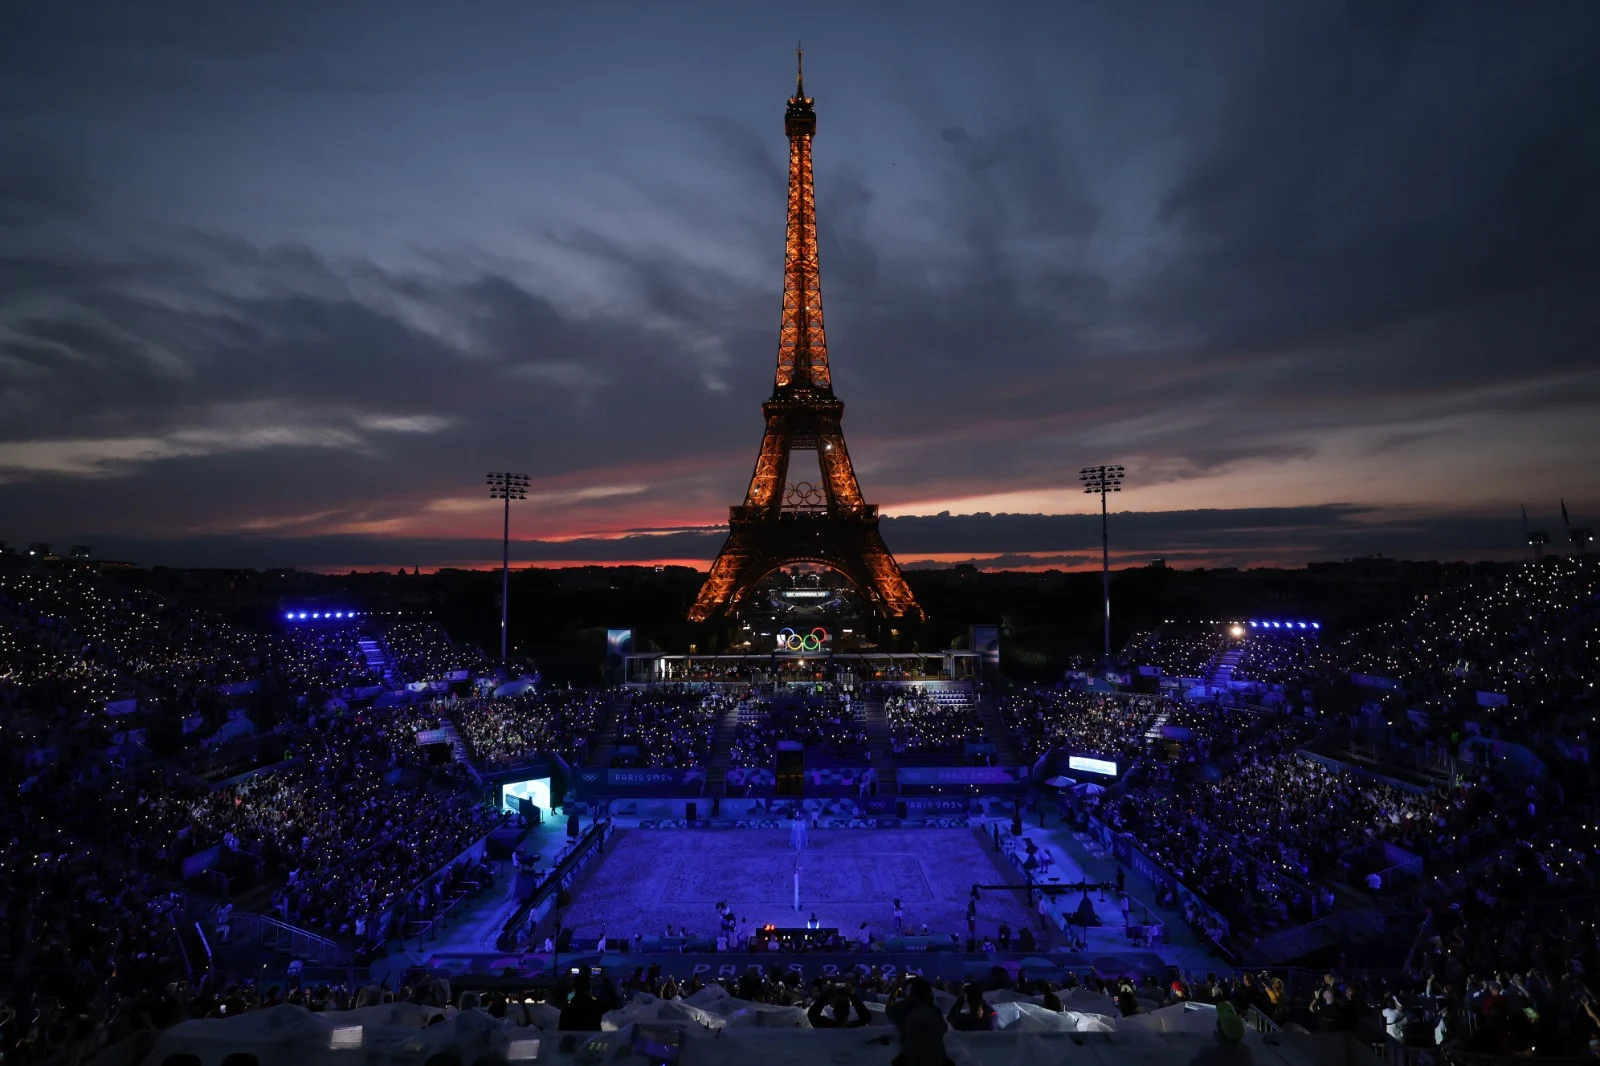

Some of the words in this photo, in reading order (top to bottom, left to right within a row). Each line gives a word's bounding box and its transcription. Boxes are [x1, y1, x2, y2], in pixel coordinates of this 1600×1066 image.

[938, 772, 967, 780] PARIS
[971, 772, 996, 780] 2024
[936, 801, 963, 809] 2024
[692, 964, 803, 976] PARS
